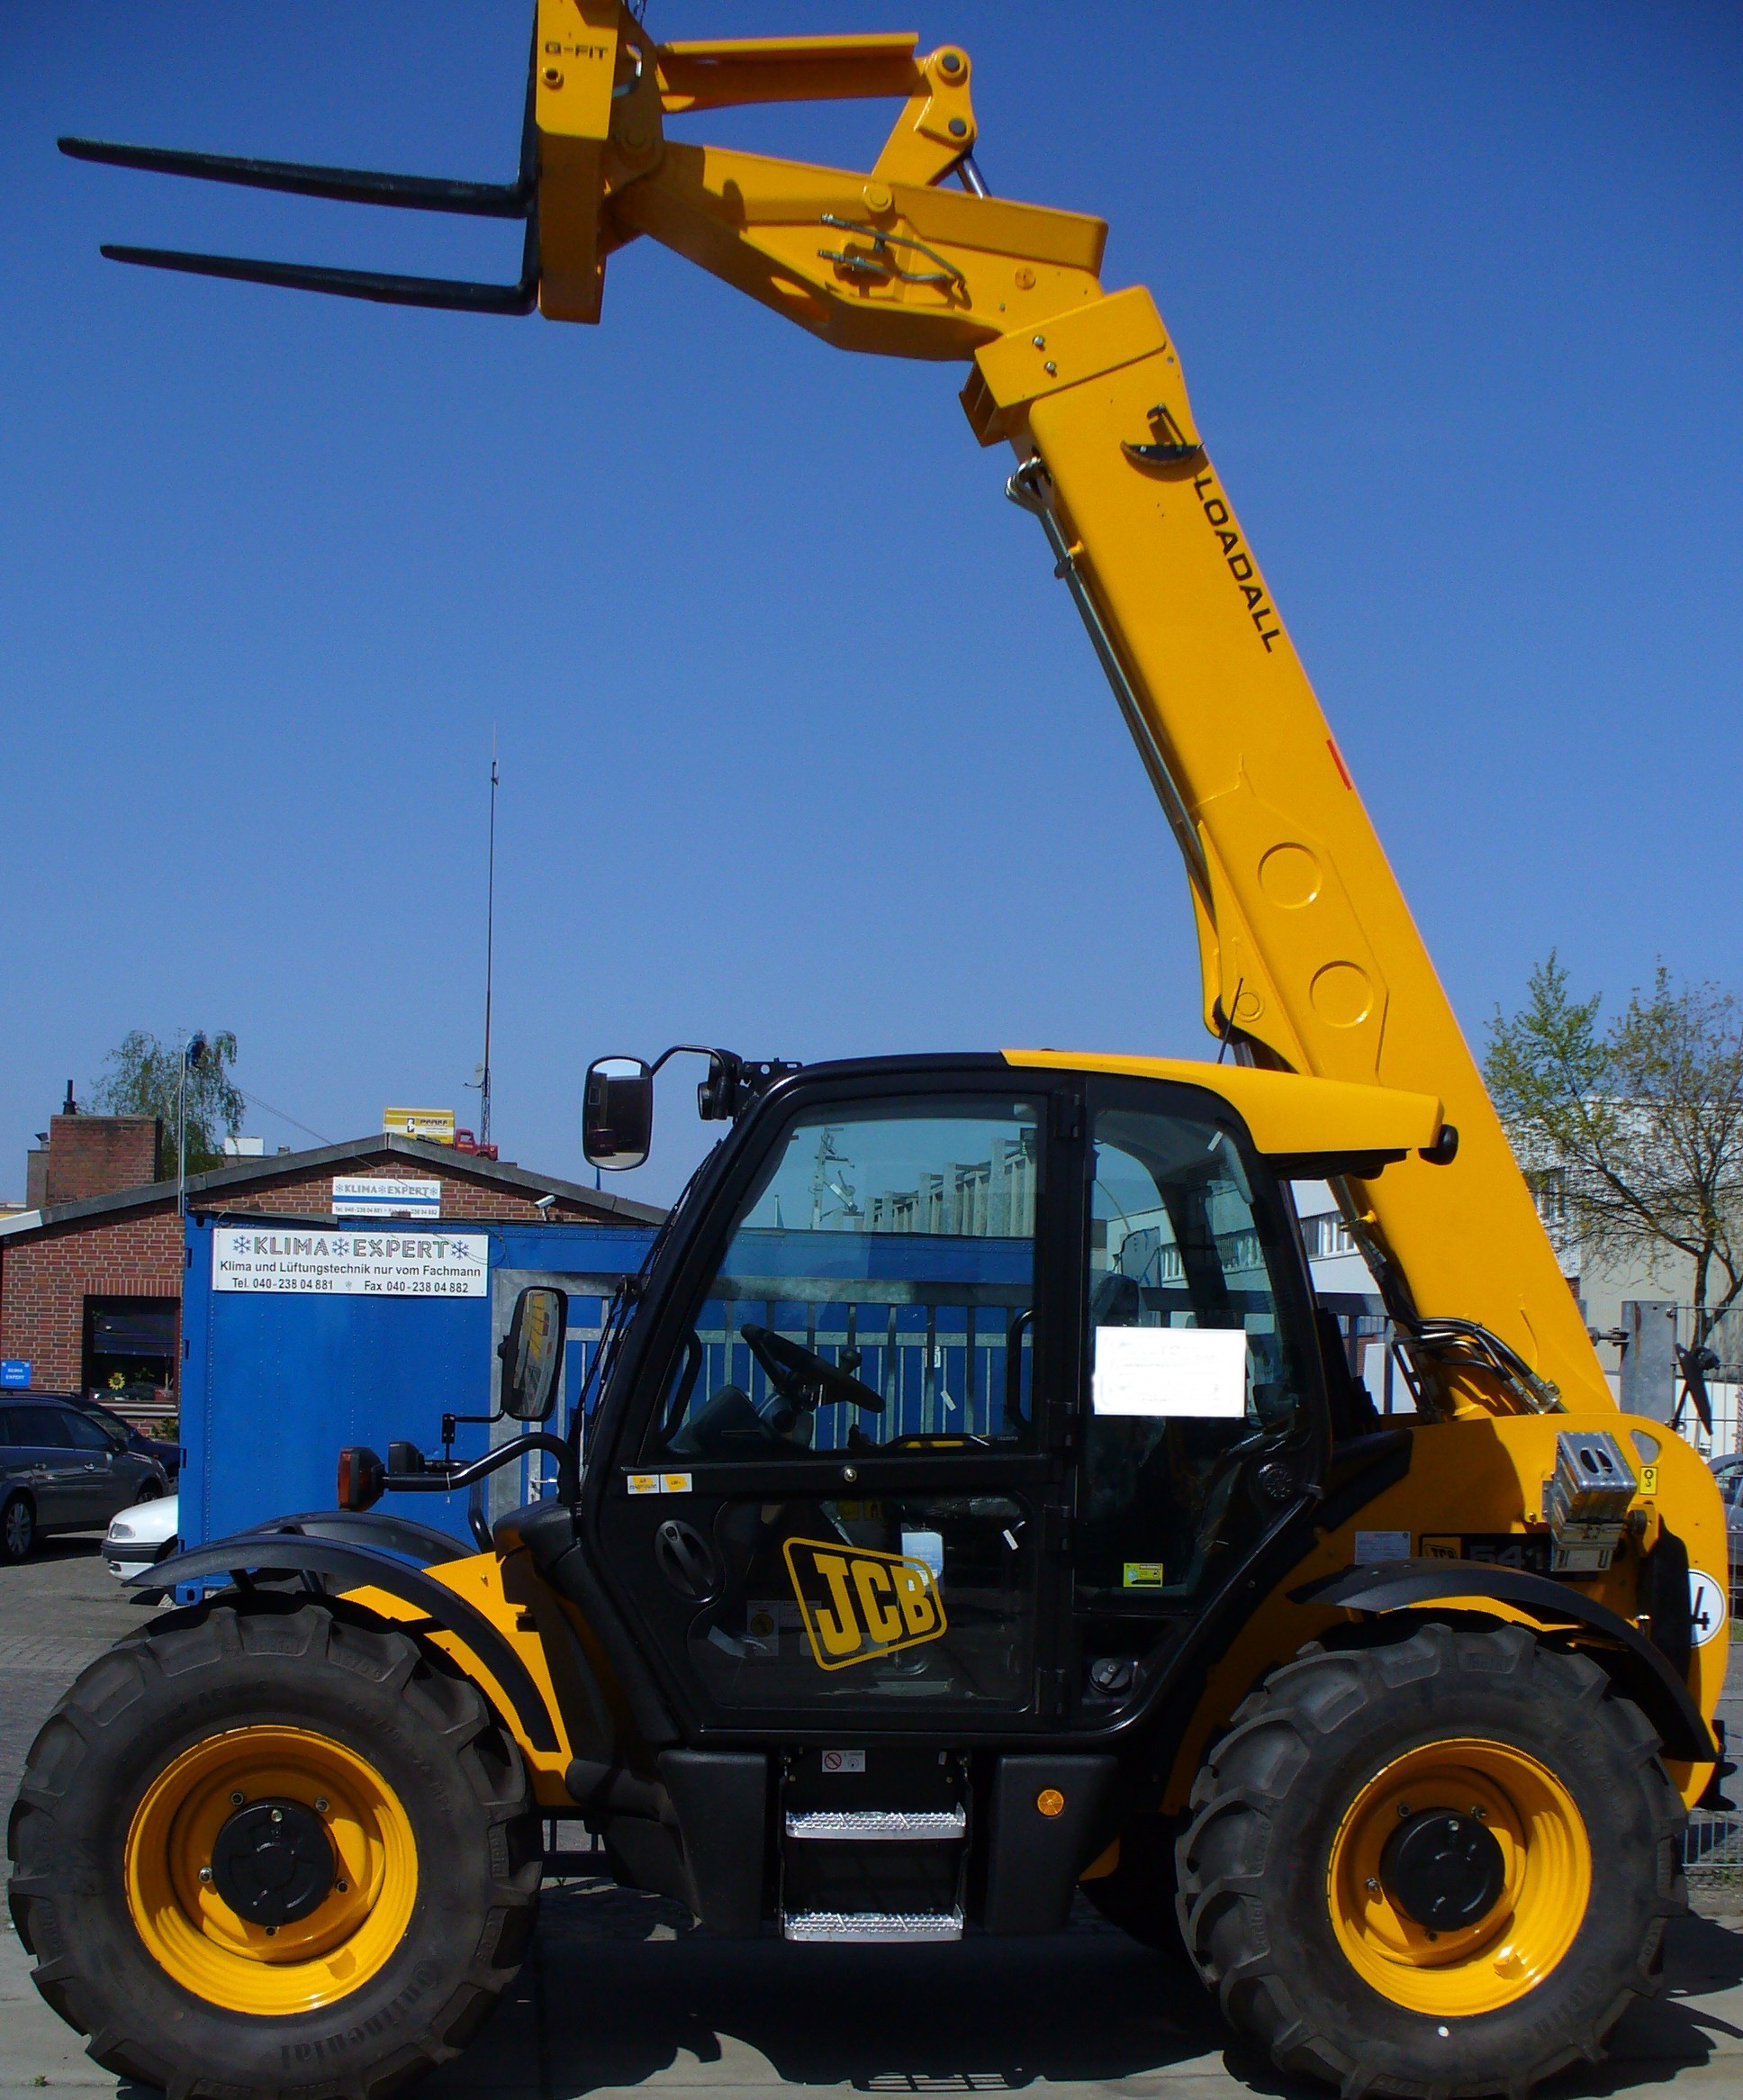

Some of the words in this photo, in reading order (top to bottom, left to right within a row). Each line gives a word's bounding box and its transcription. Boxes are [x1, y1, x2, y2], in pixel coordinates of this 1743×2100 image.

[1193, 476, 1280, 653] LOADALL
[344, 1183, 377, 1194] KLIMA
[387, 1185, 429, 1196] EXPERT
[254, 1236, 330, 1256] KLIMA
[353, 1238, 449, 1259] EXPERT
[221, 1261, 252, 1272] Klima
[255, 1262, 276, 1272] und
[279, 1262, 371, 1275] Lüftungstechnik
[374, 1266, 393, 1275] nur
[395, 1267, 420, 1275] vom
[422, 1264, 481, 1277] Fachmann
[364, 1281, 383, 1291] Fax
[812, 1552, 935, 1656] JCB
